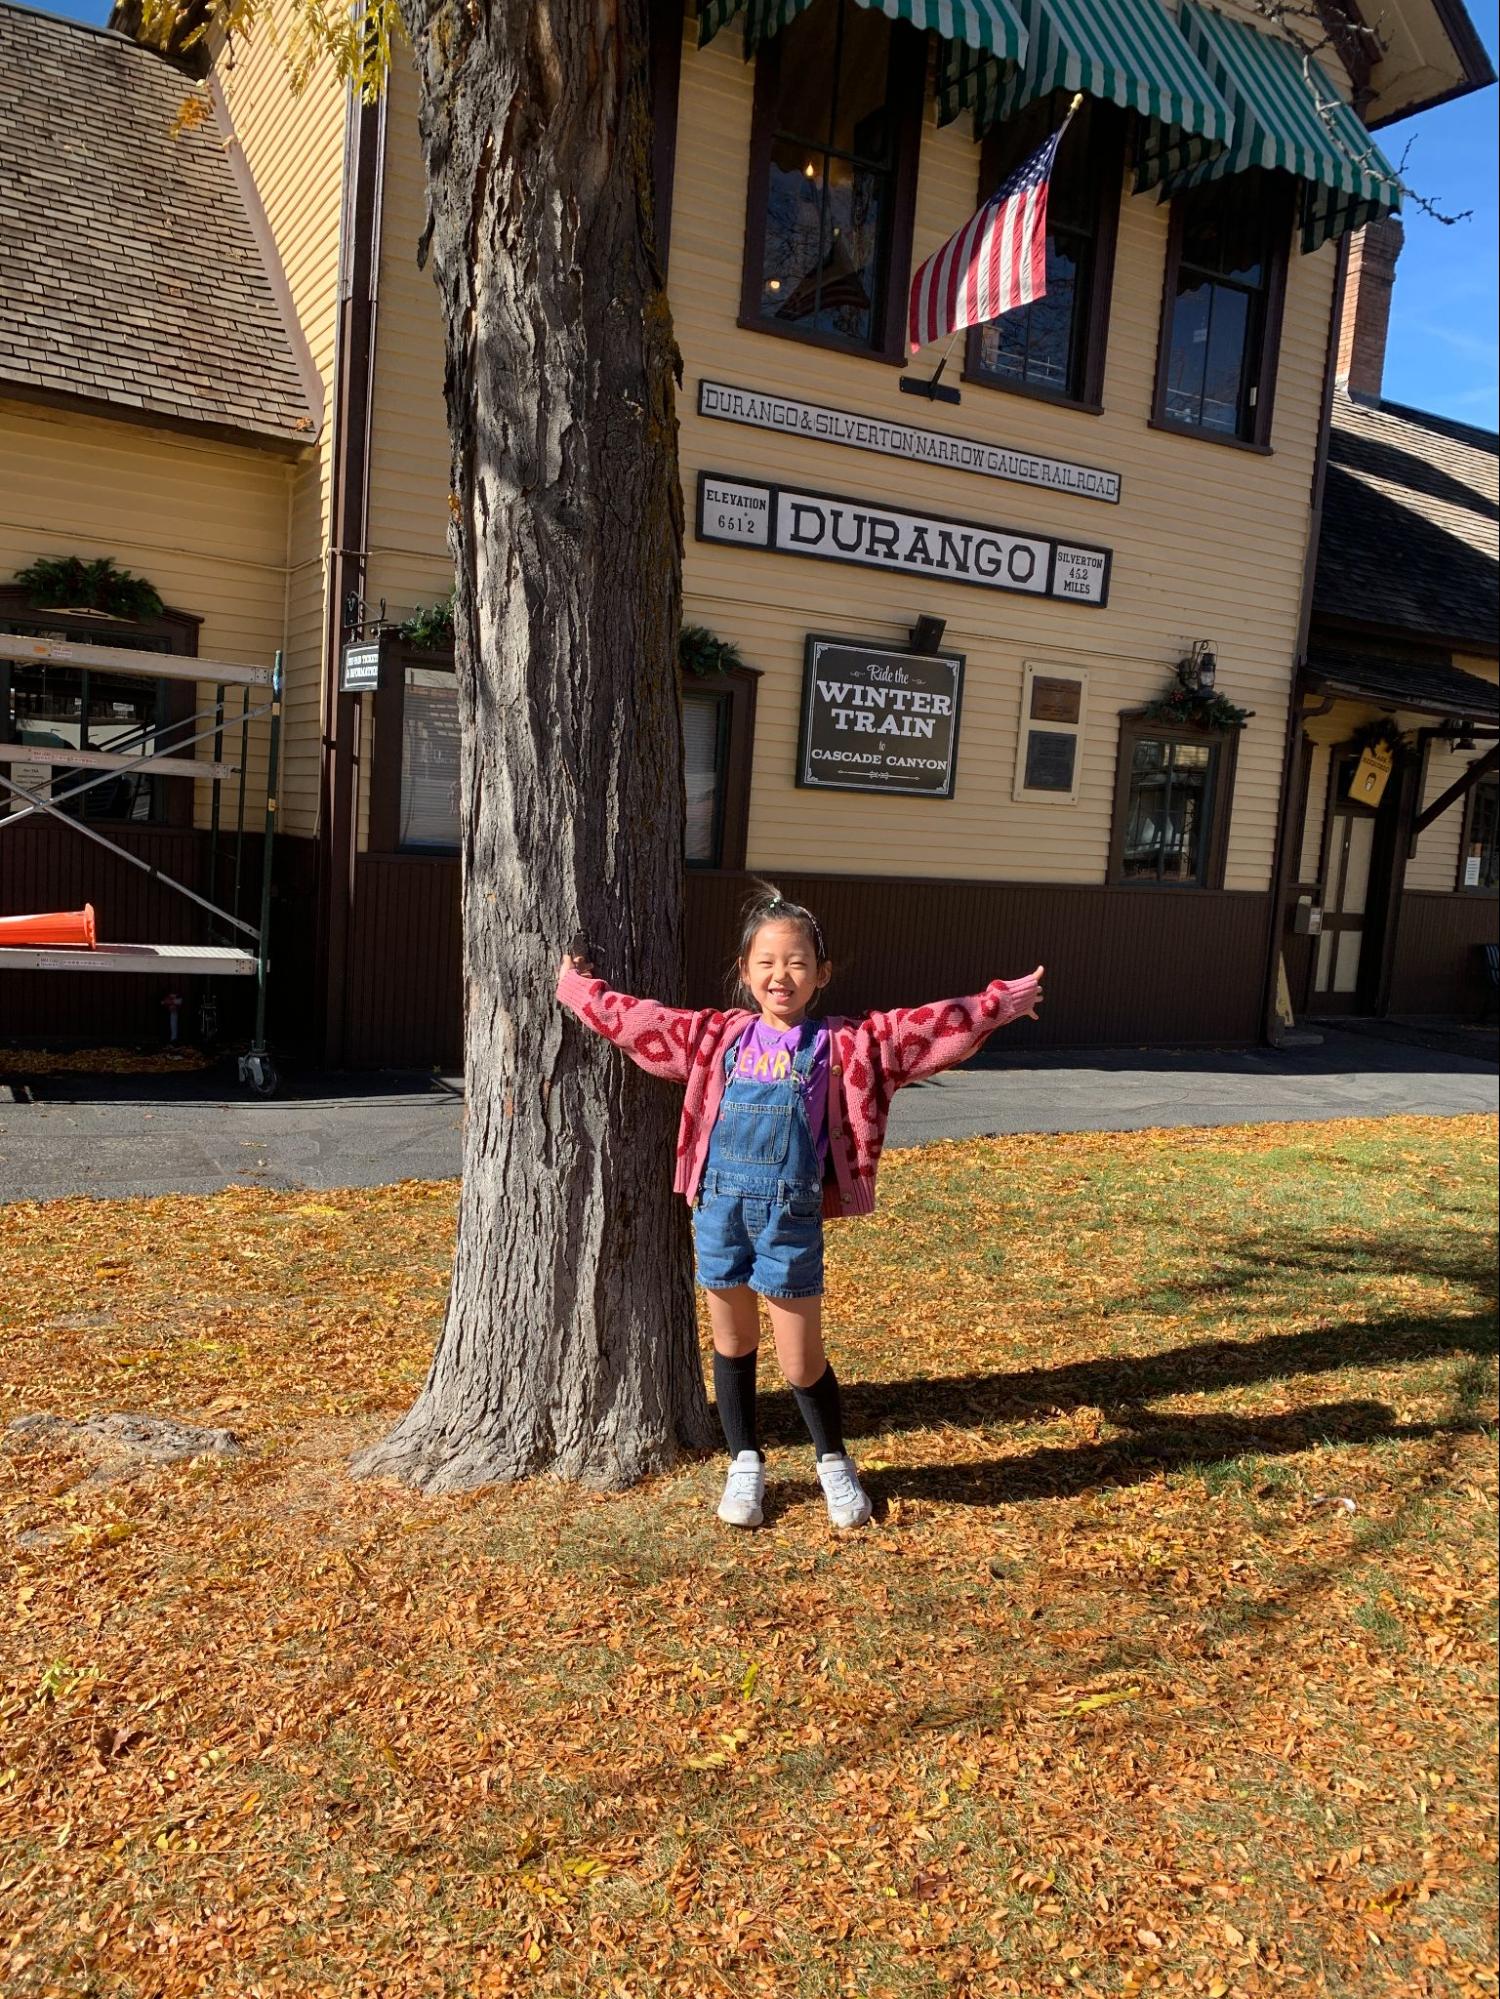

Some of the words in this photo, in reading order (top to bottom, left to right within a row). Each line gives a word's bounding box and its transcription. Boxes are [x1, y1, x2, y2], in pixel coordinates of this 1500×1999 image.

[705, 388, 798, 427] DURANGO
[800, 410, 813, 431] &
[815, 413, 914, 453] SILVERTON
[916, 435, 985, 468] NARROW
[987, 452, 1040, 480] GAUGE
[1041, 464, 1116, 496] RAILROAD
[706, 489, 766, 511] ELEVATION
[789, 502, 1036, 583] DURANGO
[1057, 551, 1103, 569] SILVERTON
[1063, 579, 1091, 595] MILES
[866, 664, 893, 682] Ride
[894, 667, 909, 685] the
[816, 679, 952, 716] WINTER
[831, 708, 935, 739] TRAIN
[878, 740, 886, 751] to
[811, 749, 882, 765] CASCADE
[886, 755, 948, 770] CANYON
